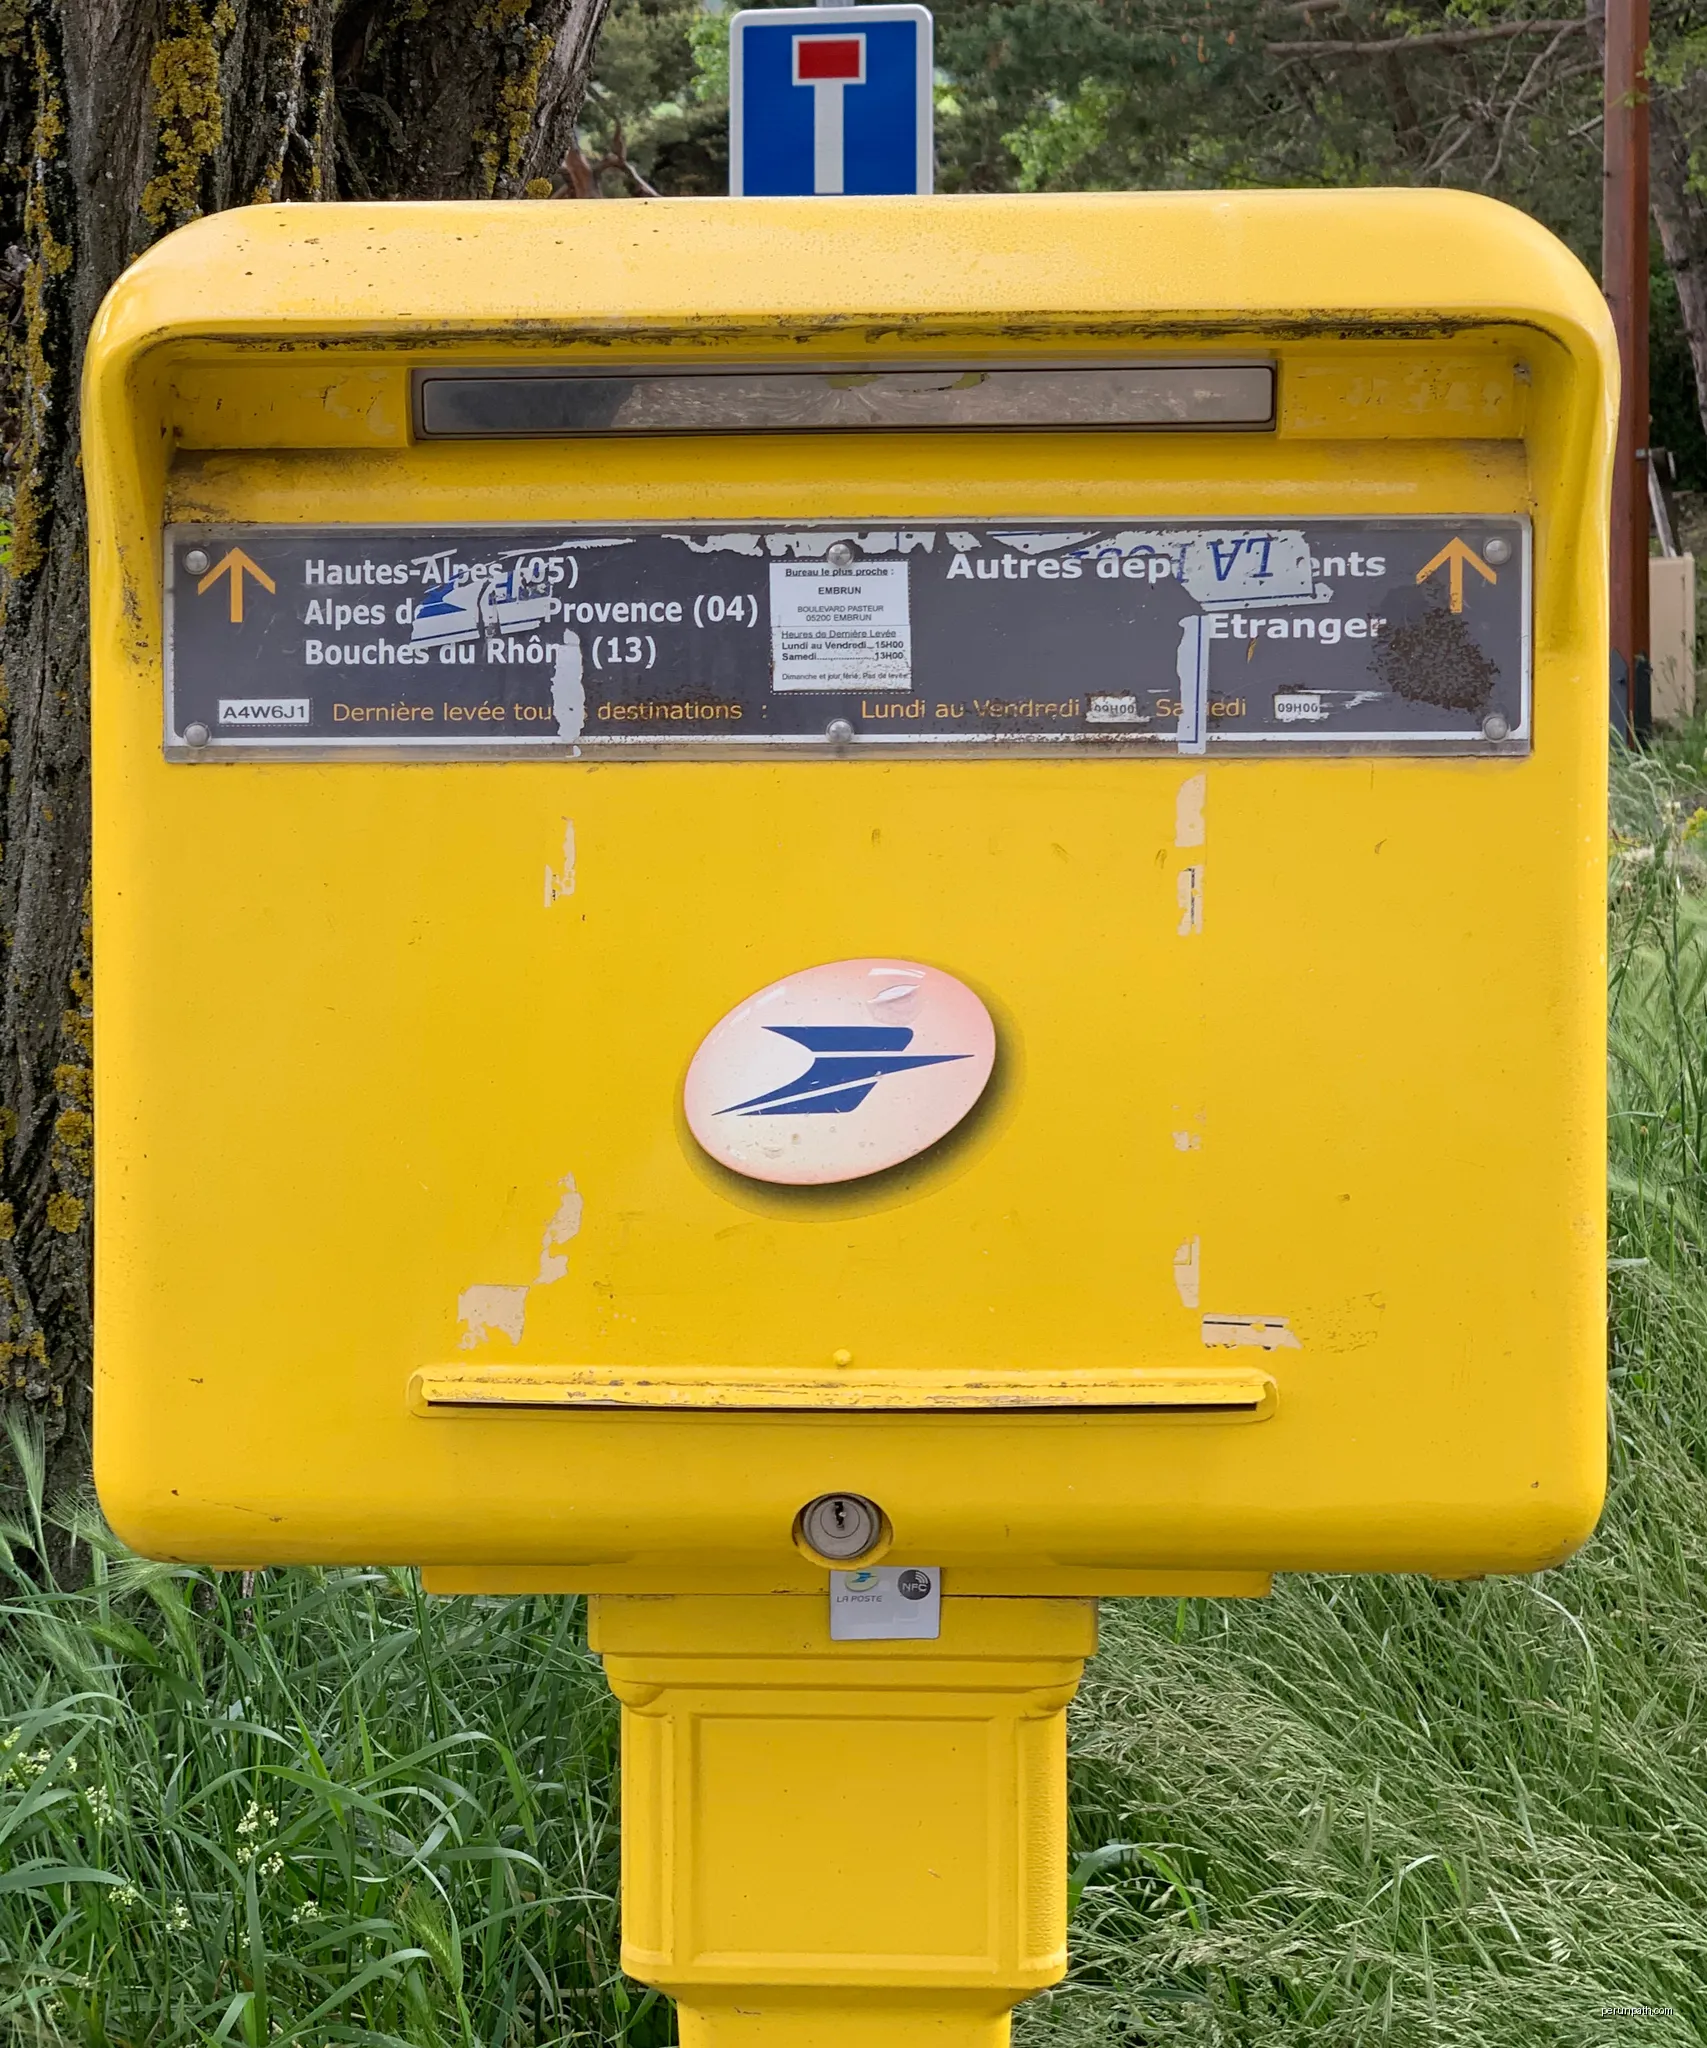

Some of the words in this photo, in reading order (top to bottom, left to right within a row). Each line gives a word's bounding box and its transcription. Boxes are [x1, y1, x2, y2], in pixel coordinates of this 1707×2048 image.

[304, 558, 503, 586] Hautes-Alpes
[515, 556, 579, 589] (05)
[785, 569, 819, 577] Bureau
[821, 568, 830, 576] le
[833, 568, 853, 578] plus
[856, 568, 888, 578] proche
[946, 554, 1082, 579] Autres
[818, 587, 862, 595] EMBRUN
[304, 598, 385, 631] Alpes
[545, 597, 683, 623] Provence
[693, 595, 759, 628] (04)
[797, 605, 846, 613] BOULEVARD
[781, 630, 813, 639] Heures
[815, 630, 827, 638] de
[829, 630, 867, 638] Dernière
[869, 629, 896, 638] Levée
[1210, 613, 1388, 643] Etranger
[305, 638, 429, 665] Bouches
[439, 641, 475, 664] du
[487, 635, 562, 665] Rhôn
[592, 636, 657, 669] (13)
[782, 641, 808, 650] Lundi
[875, 641, 904, 649] 15H00
[874, 652, 904, 660] 13H00
[223, 704, 305, 720] A4W6J1
[333, 701, 434, 722] Dernière
[443, 701, 506, 721] levée
[598, 701, 742, 720] destinations
[861, 699, 926, 719] Lundi
[935, 702, 964, 719] au
[974, 698, 1080, 719] Vendredi
[1156, 698, 1247, 717] Saedi
[1277, 702, 1319, 713] 09H00
[902, 1582, 928, 1593] NFC
[836, 1595, 849, 1603] LA
[851, 1595, 883, 1603] POSTE
